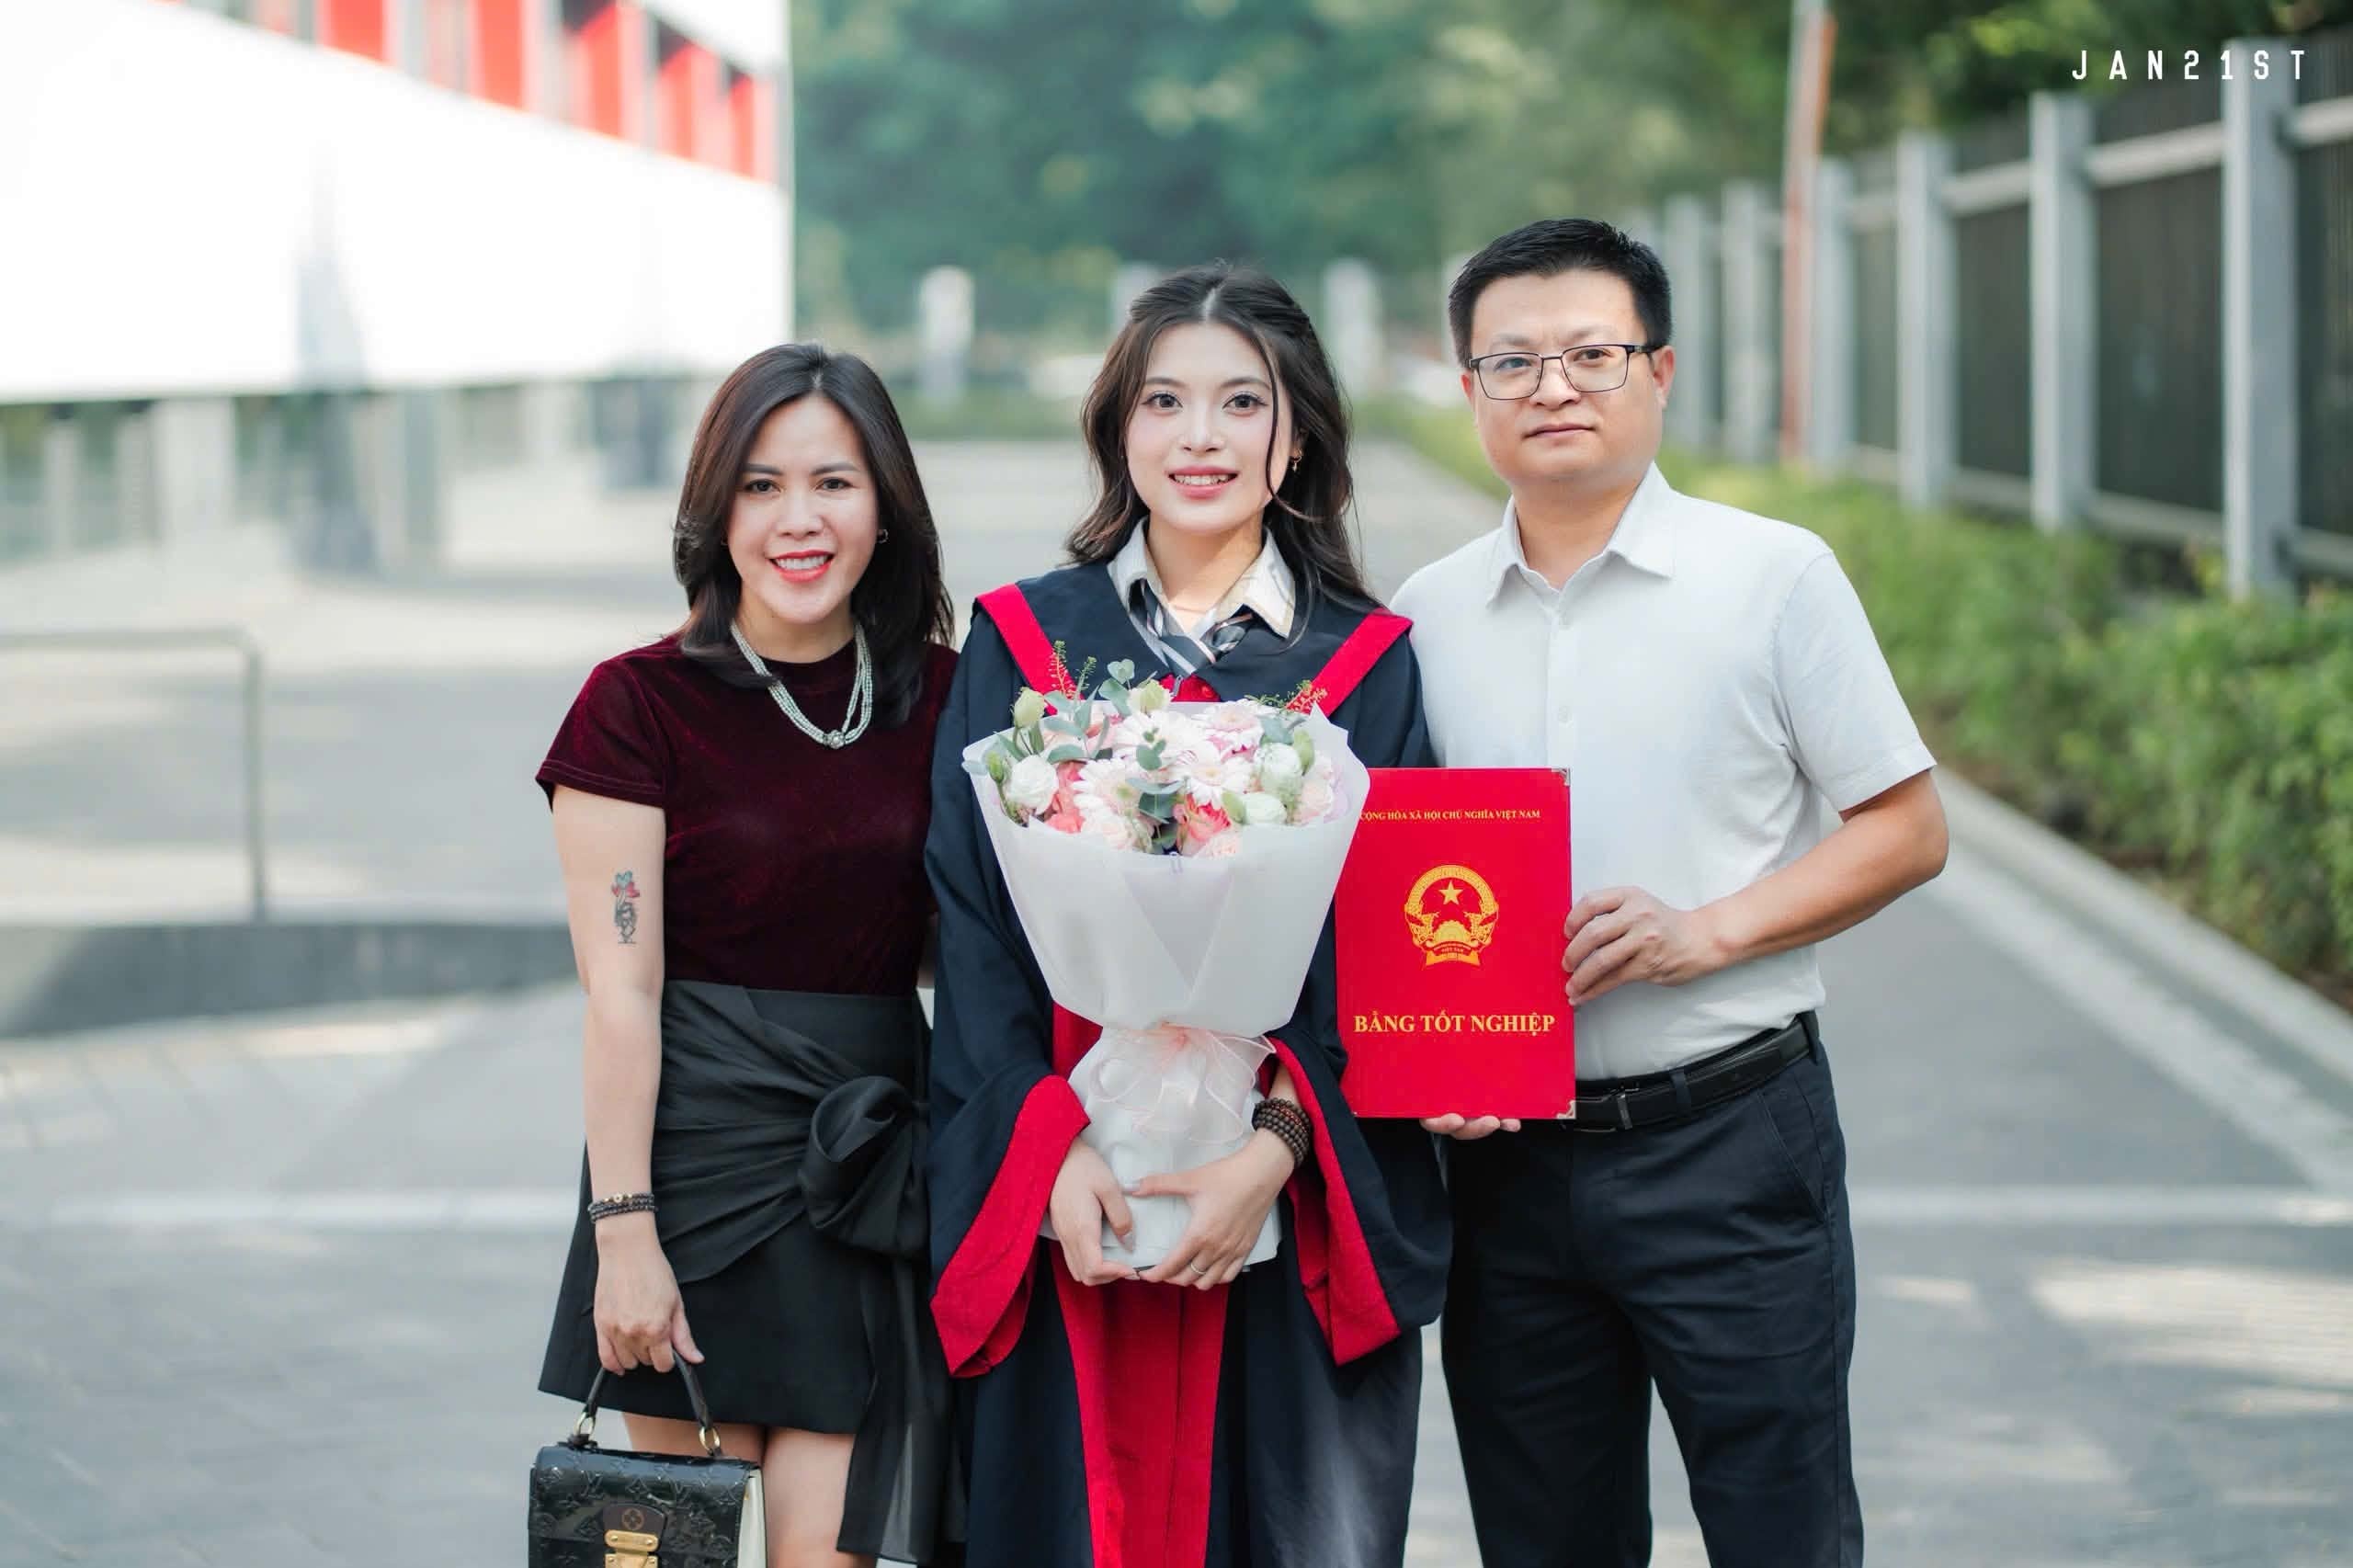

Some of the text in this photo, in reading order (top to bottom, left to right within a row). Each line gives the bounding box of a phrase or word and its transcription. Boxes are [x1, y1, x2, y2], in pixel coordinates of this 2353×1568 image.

[1518, 809, 1541, 819] NAM
[1354, 1009, 1555, 1037] BẰNG TỐT NGHIỆP
